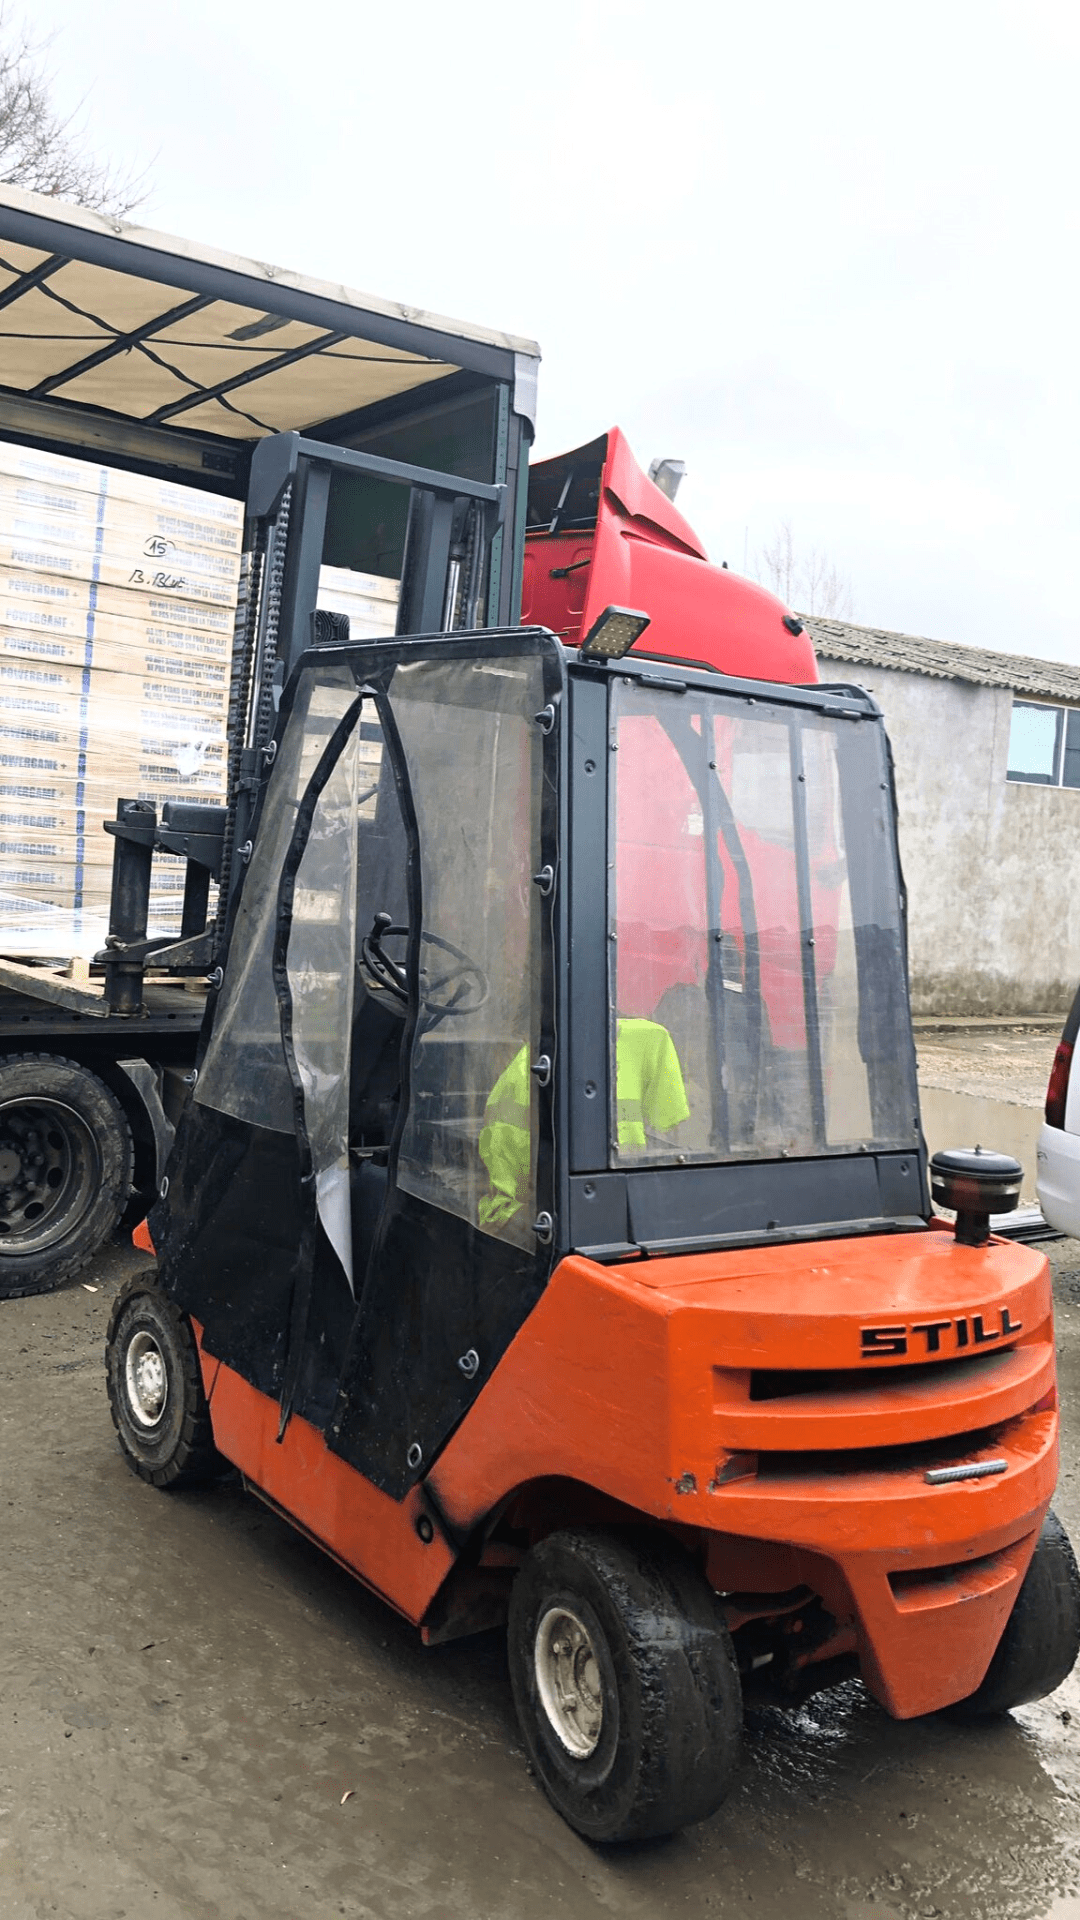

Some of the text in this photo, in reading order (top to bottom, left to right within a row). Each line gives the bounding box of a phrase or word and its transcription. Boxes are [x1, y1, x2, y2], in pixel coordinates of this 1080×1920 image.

[149, 540, 168, 554] 15
[0, 754, 58, 771] OWERGAME
[0, 813, 58, 829] OWERGAME
[0, 842, 57, 856] OWERGAME
[859, 1305, 1022, 1358] STILL
